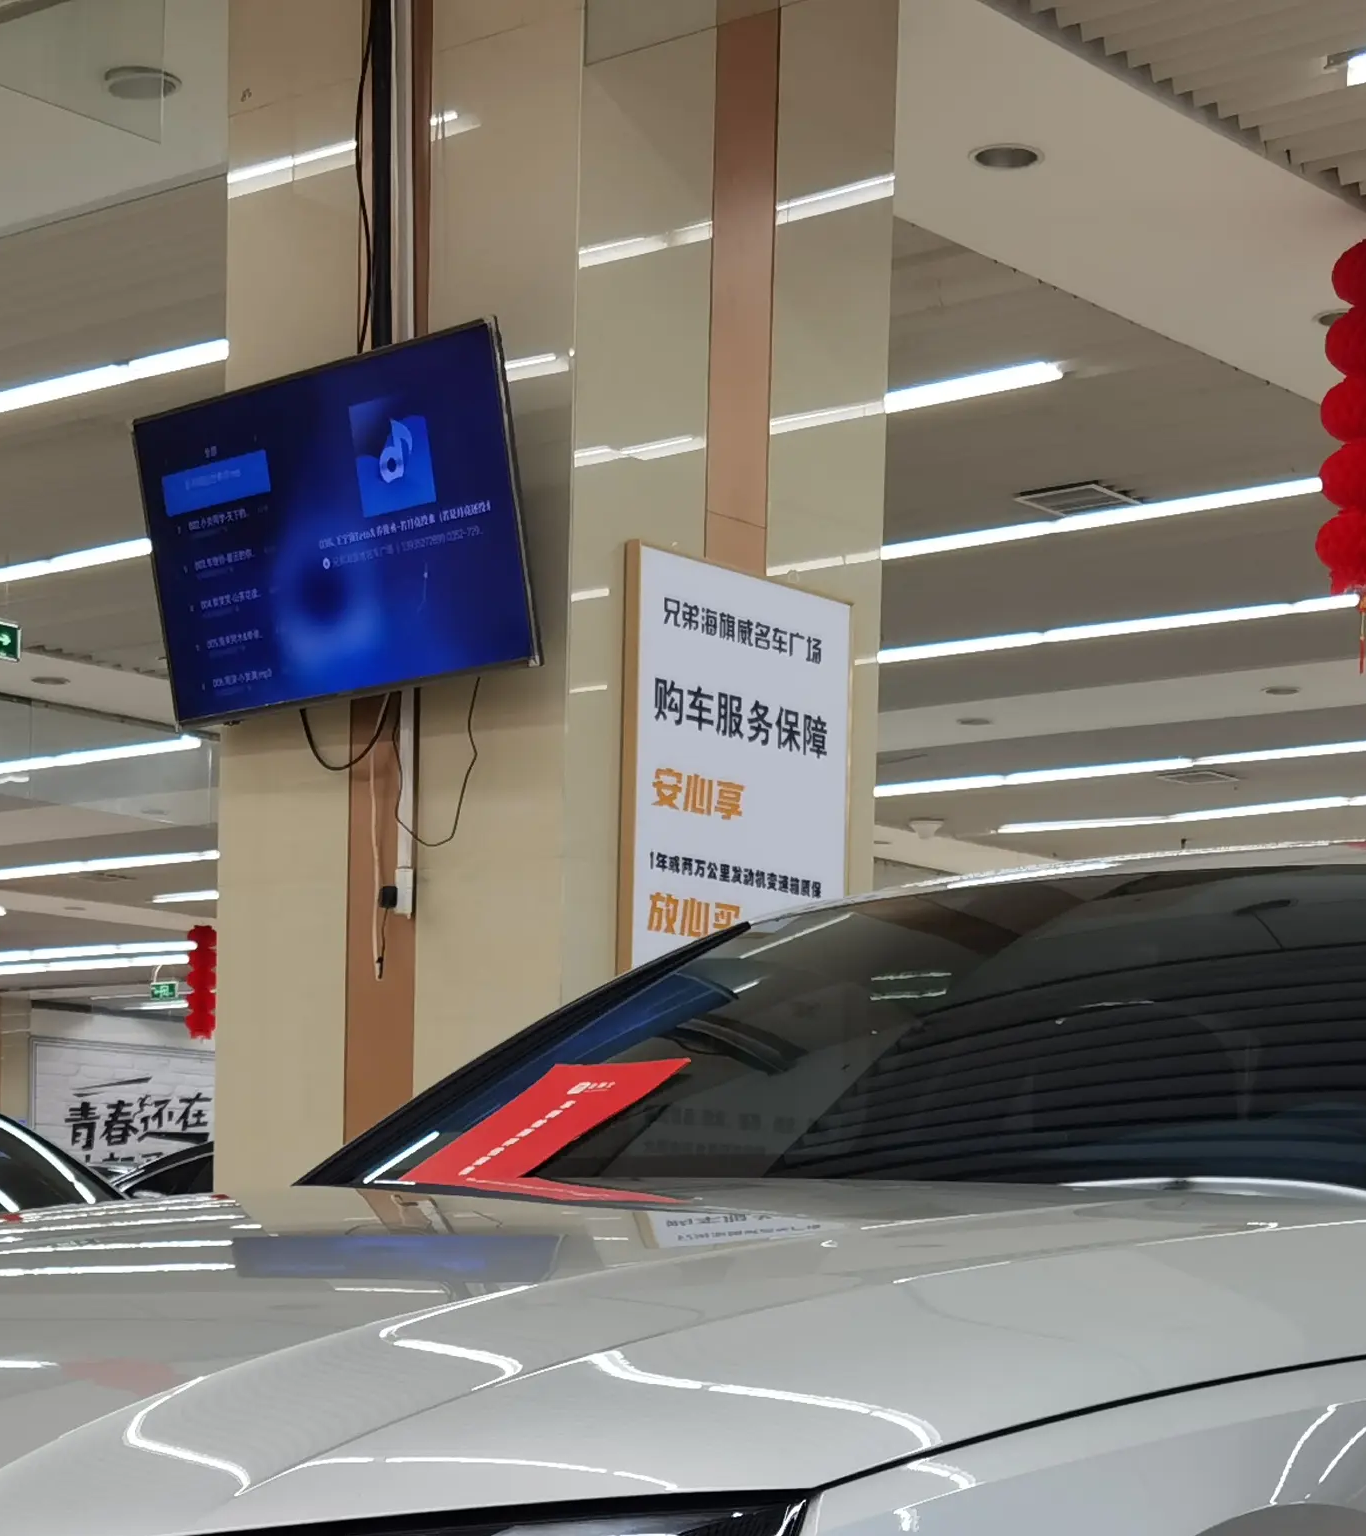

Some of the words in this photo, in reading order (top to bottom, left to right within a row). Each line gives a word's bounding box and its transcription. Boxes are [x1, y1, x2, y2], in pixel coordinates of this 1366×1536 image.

[663, 596, 823, 665] 兄弟海旗威名车广场
[653, 676, 828, 760] 购车服务保障
[651, 767, 746, 821] 安心享
[649, 850, 823, 899] 1年或两万公里发动机变速箱质保
[64, 1092, 213, 1150] 青春还在
